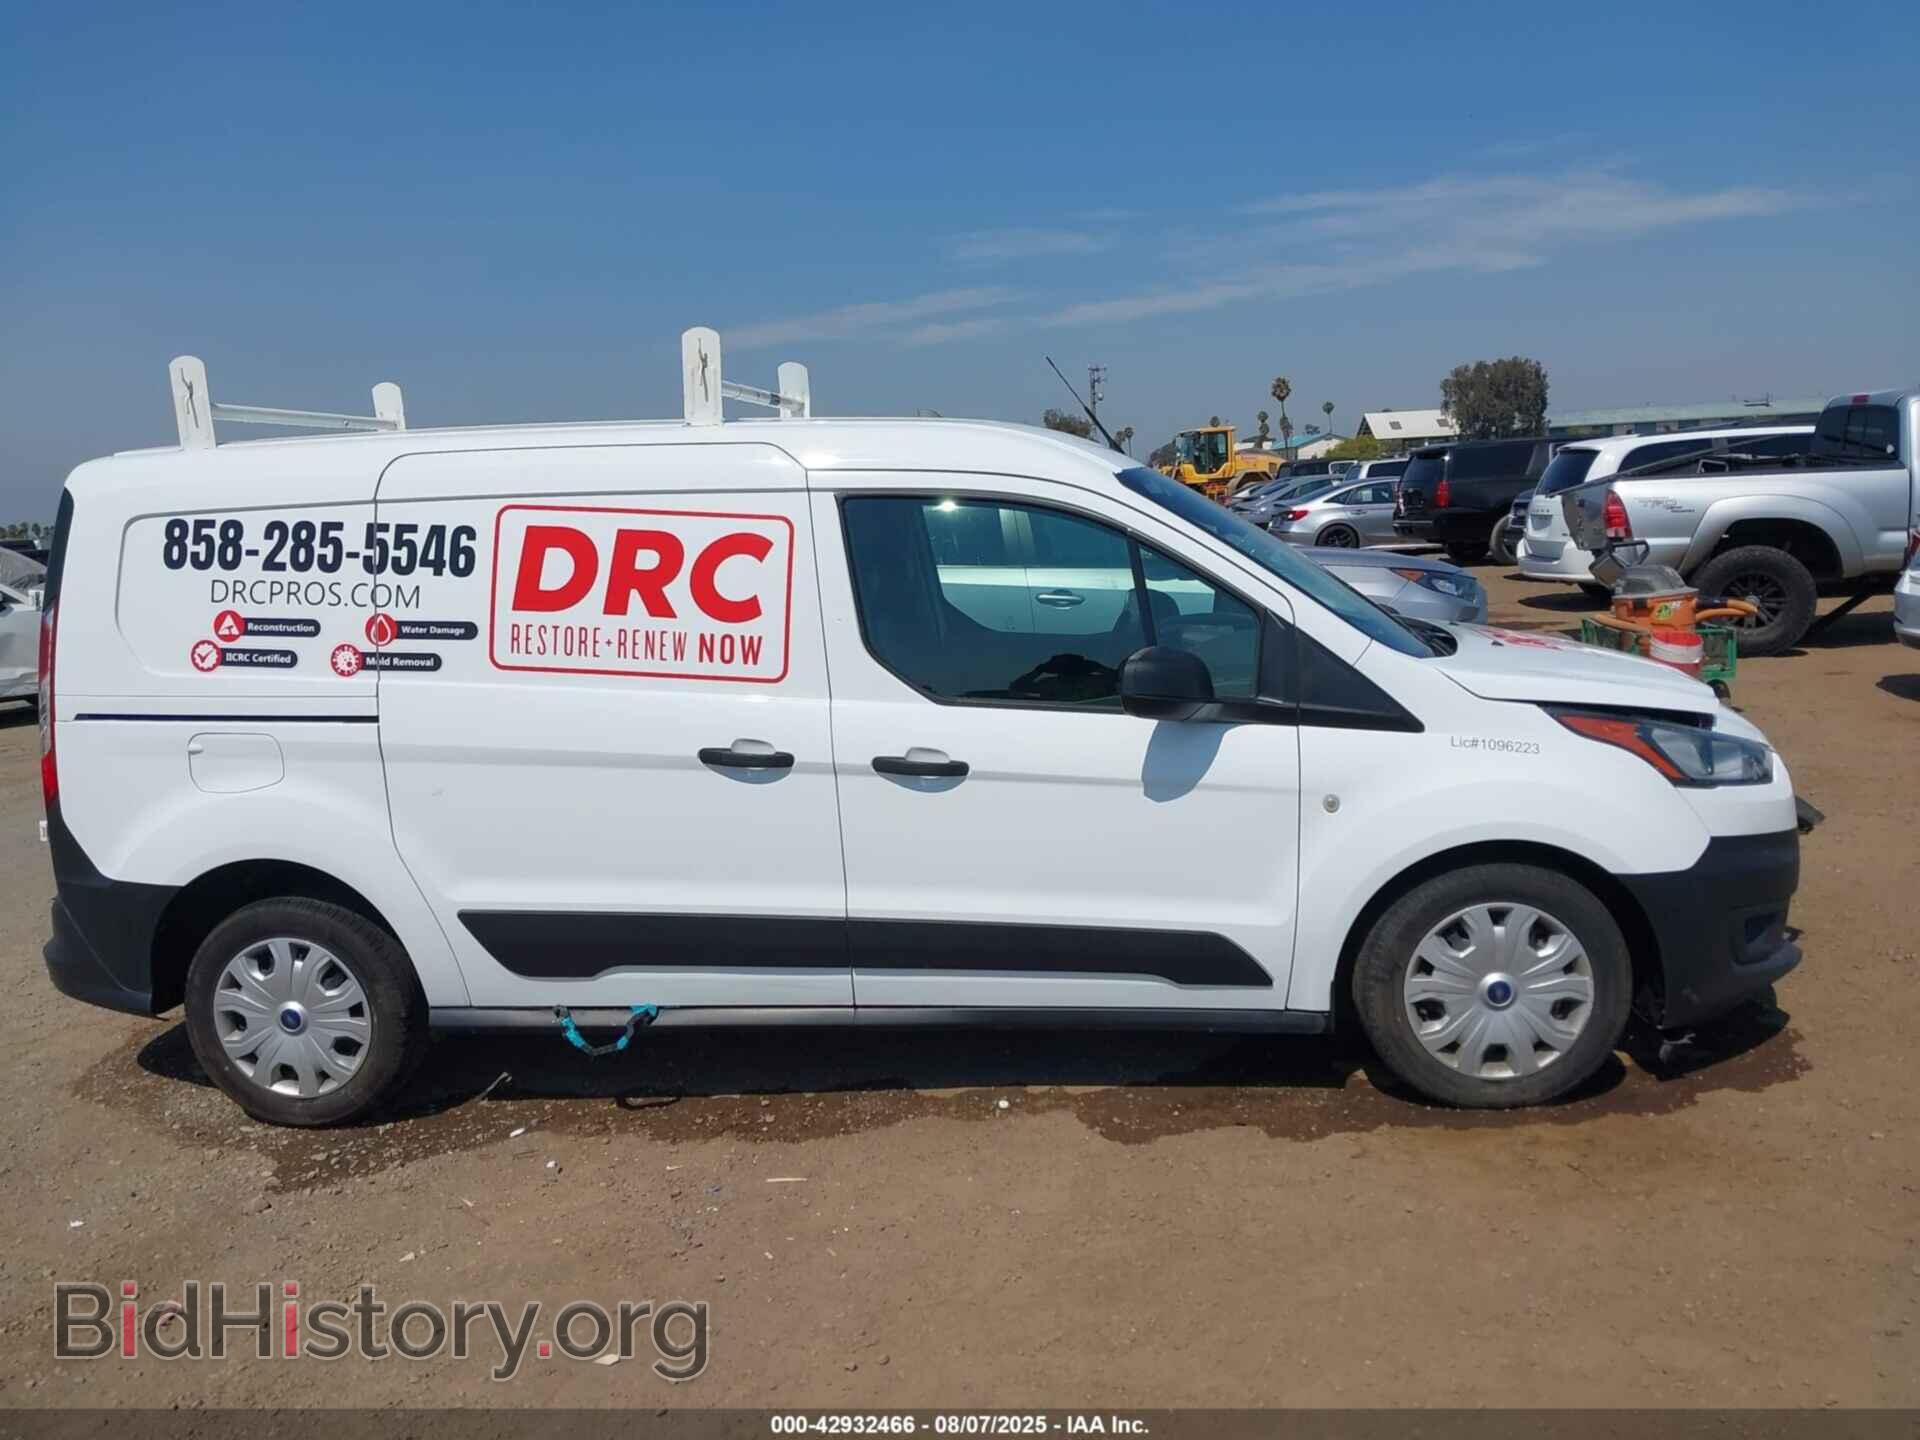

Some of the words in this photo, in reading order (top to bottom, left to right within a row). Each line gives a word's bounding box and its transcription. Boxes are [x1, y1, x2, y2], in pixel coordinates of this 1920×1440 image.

[163, 518, 477, 577] 858-285-5546
[512, 525, 775, 624] DRC
[210, 579, 421, 609] DRCPROS.COM
[247, 622, 316, 633] Reconstruction
[401, 625, 428, 635] Water
[429, 625, 465, 637] Damage
[252, 653, 292, 664] Certified
[698, 632, 763, 666] NOW
[392, 657, 435, 667] Removal
[1450, 735, 1541, 755] Lic#1096223
